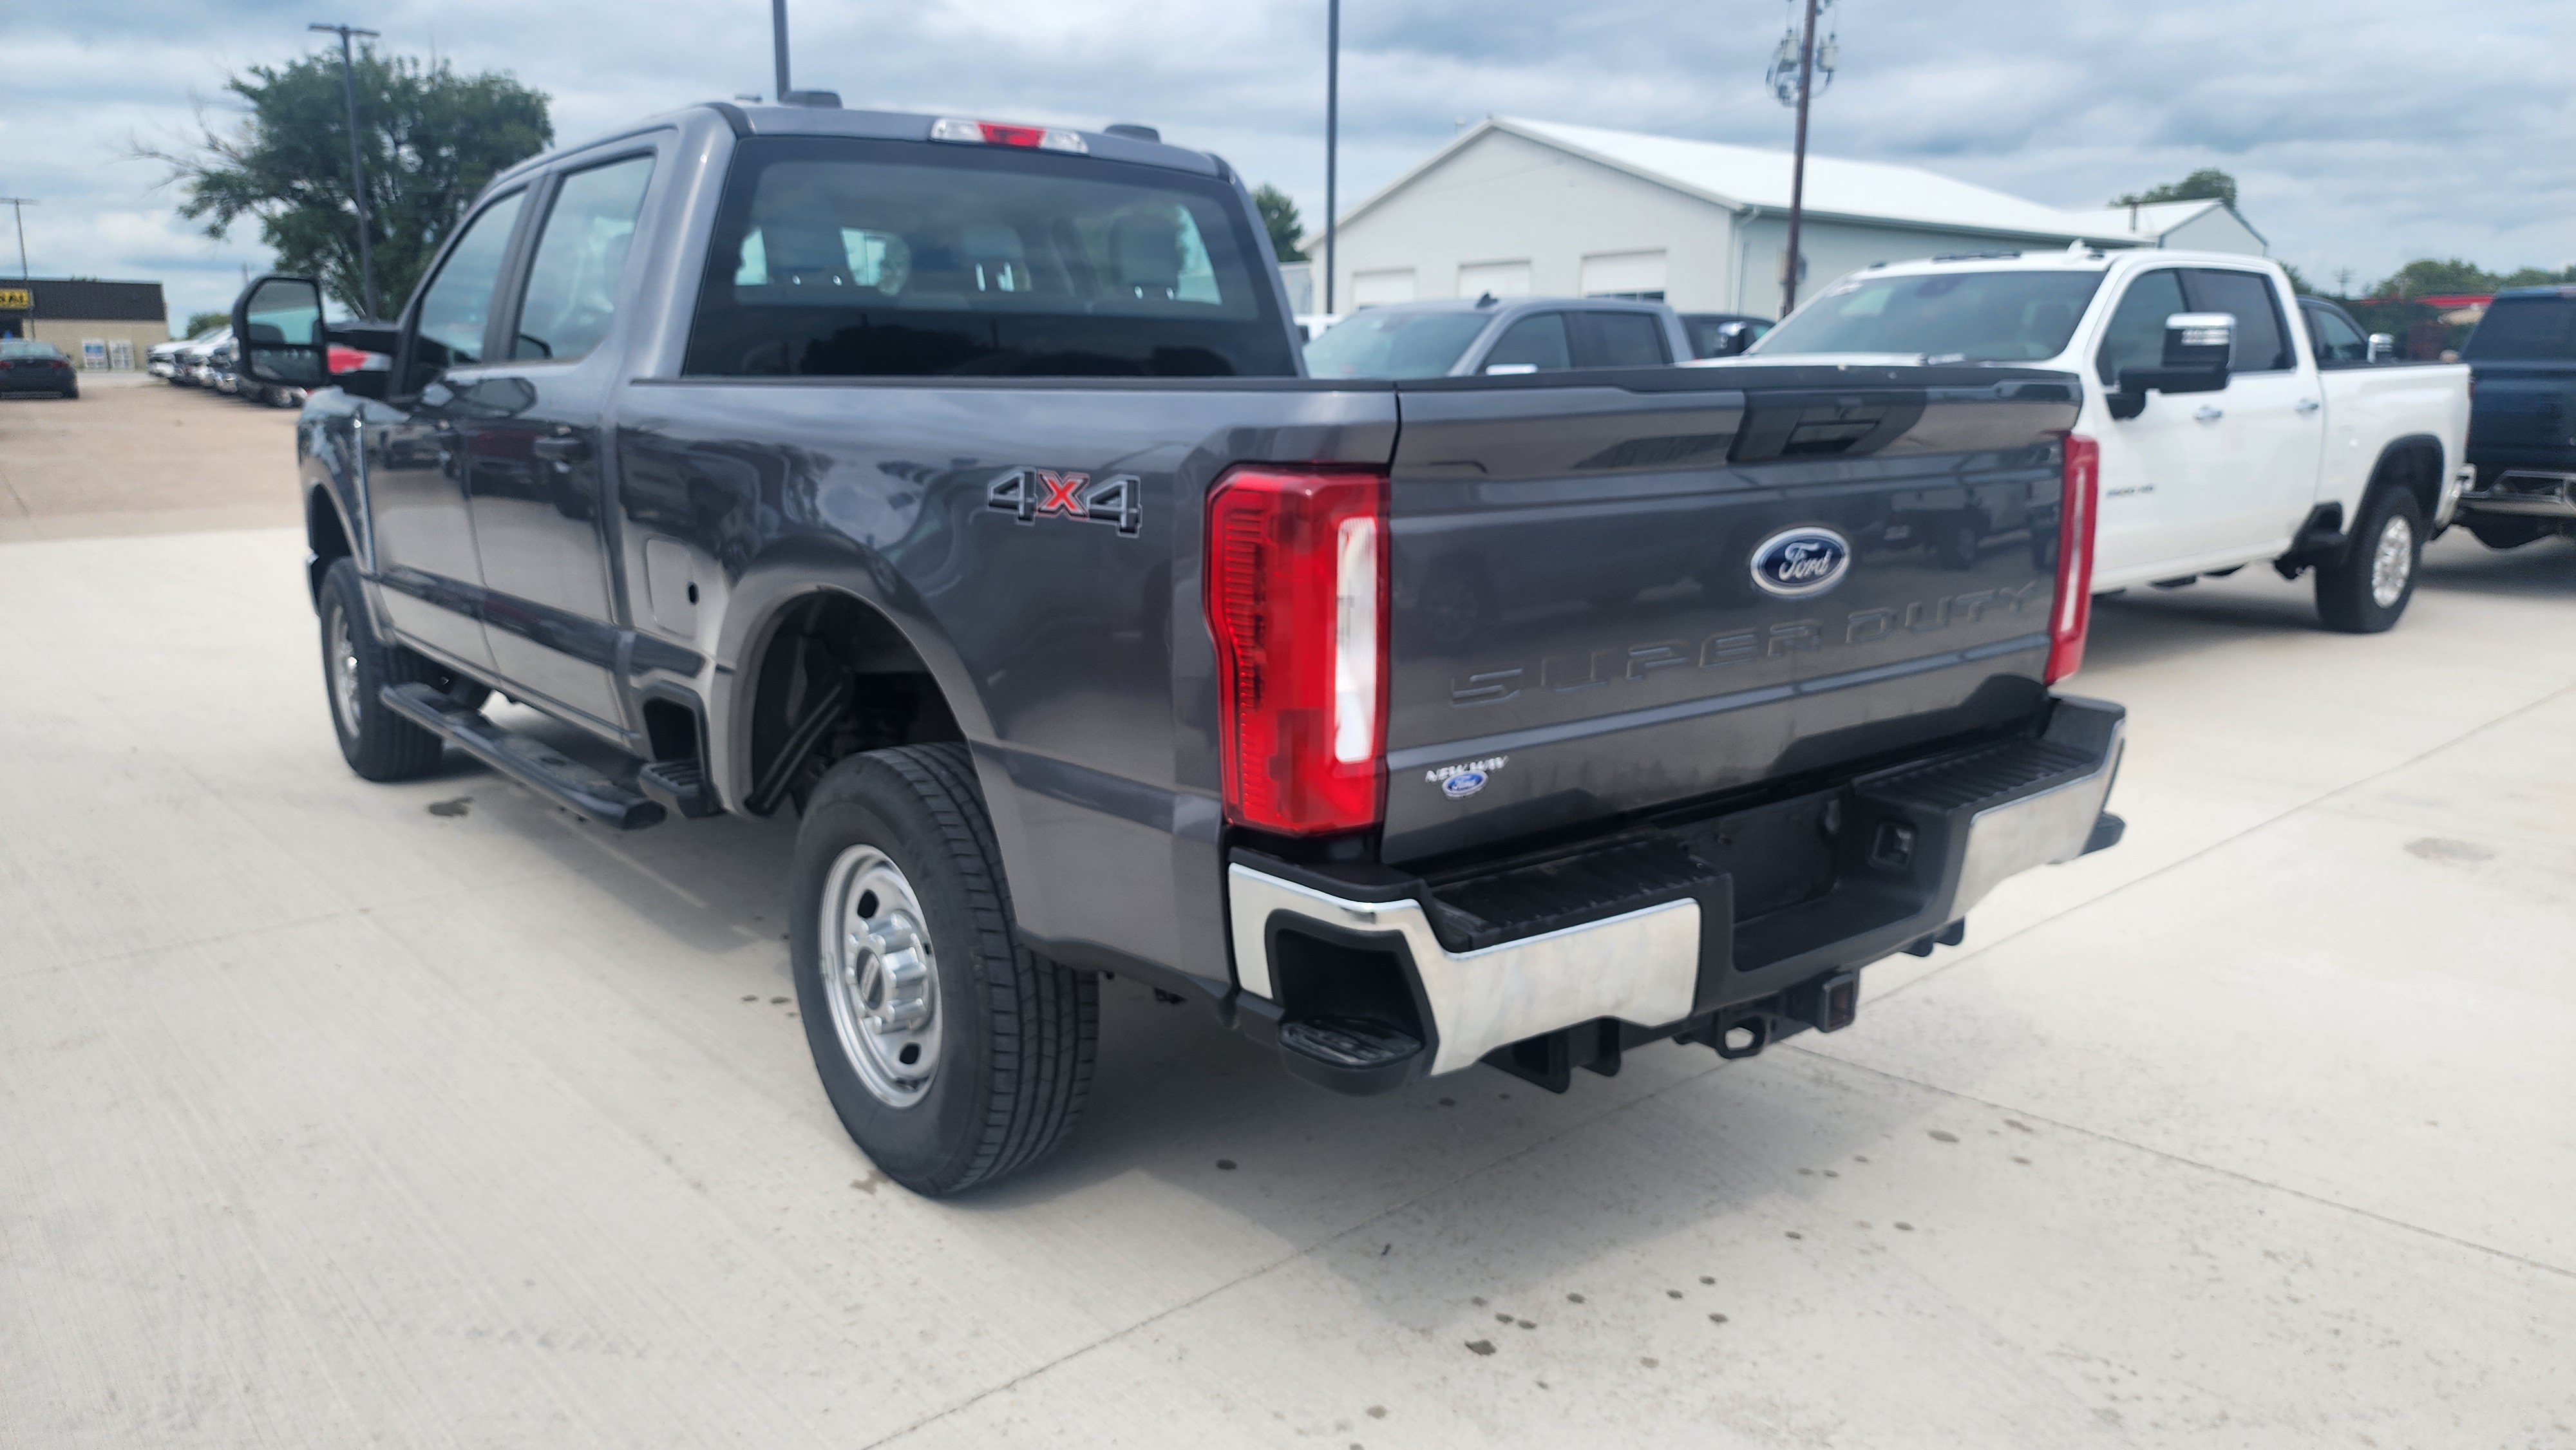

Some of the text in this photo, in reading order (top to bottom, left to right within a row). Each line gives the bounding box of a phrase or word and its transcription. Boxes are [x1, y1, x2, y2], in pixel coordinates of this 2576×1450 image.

[1779, 542, 1833, 581] Ford
[1451, 580, 2036, 708] SUPER DUTY
